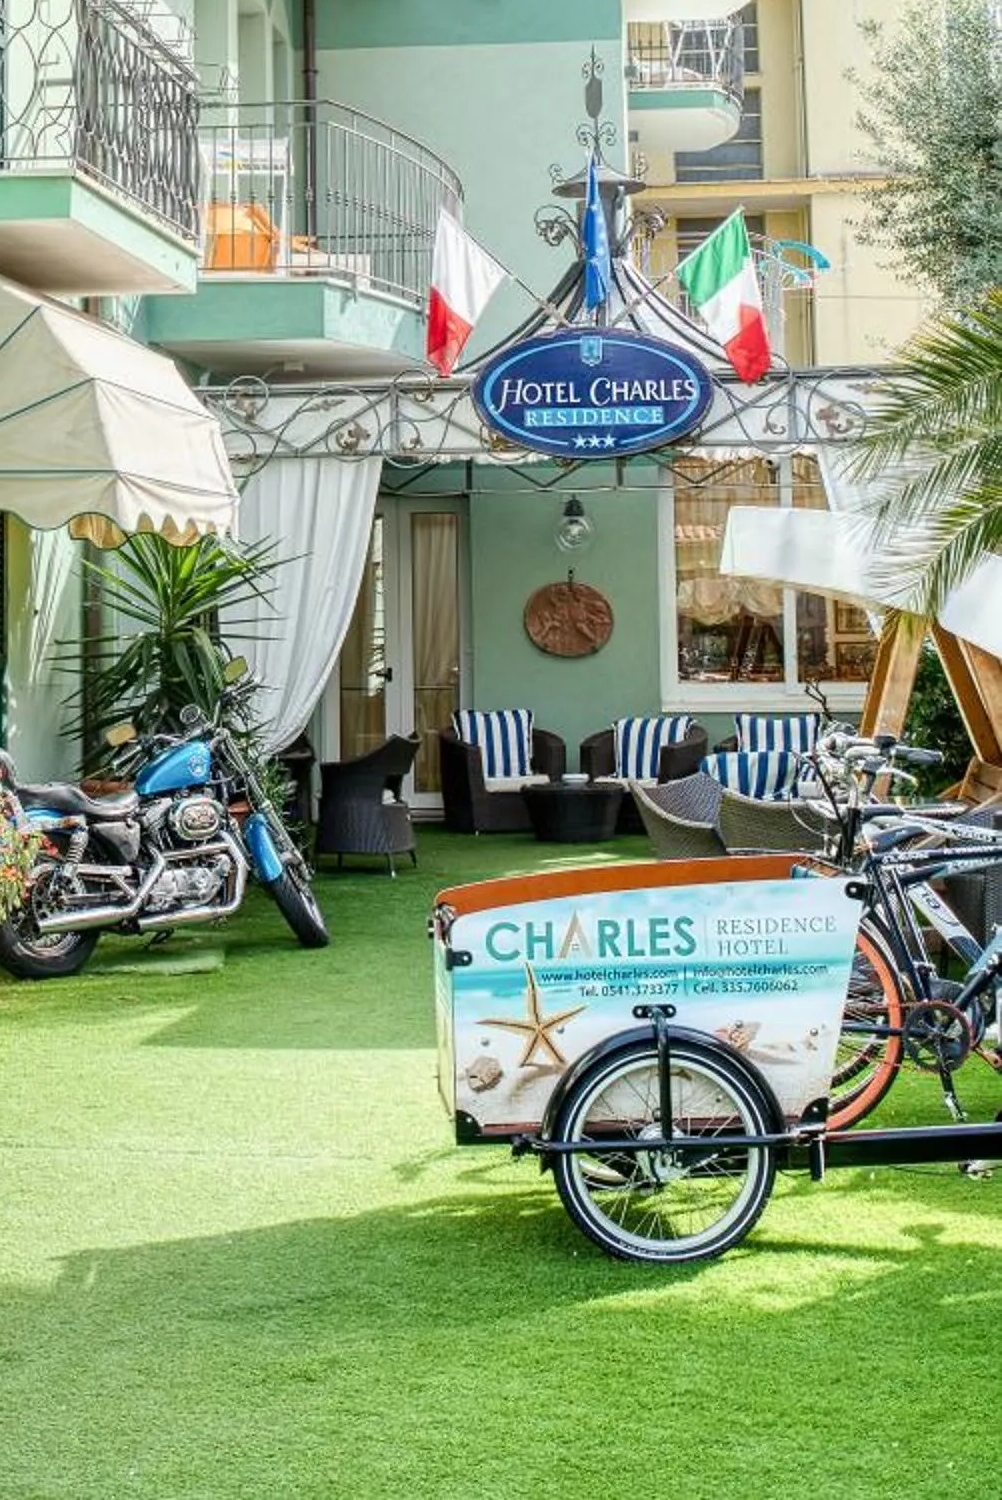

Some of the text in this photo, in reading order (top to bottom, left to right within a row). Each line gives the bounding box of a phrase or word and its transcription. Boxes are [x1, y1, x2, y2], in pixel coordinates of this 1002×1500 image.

[497, 377, 696, 412] HOTEL CHARLES
[524, 408, 664, 426] RESIDENCE
[717, 915, 838, 935] RESIDENCE
[485, 910, 697, 962] CHARLES
[718, 938, 789, 957] HOTEL
[541, 963, 829, 982] www.hotelcharles.com info@hotelcharles.com
[580, 985, 598, 998] Tel.
[601, 982, 678, 997] 0541.373377
